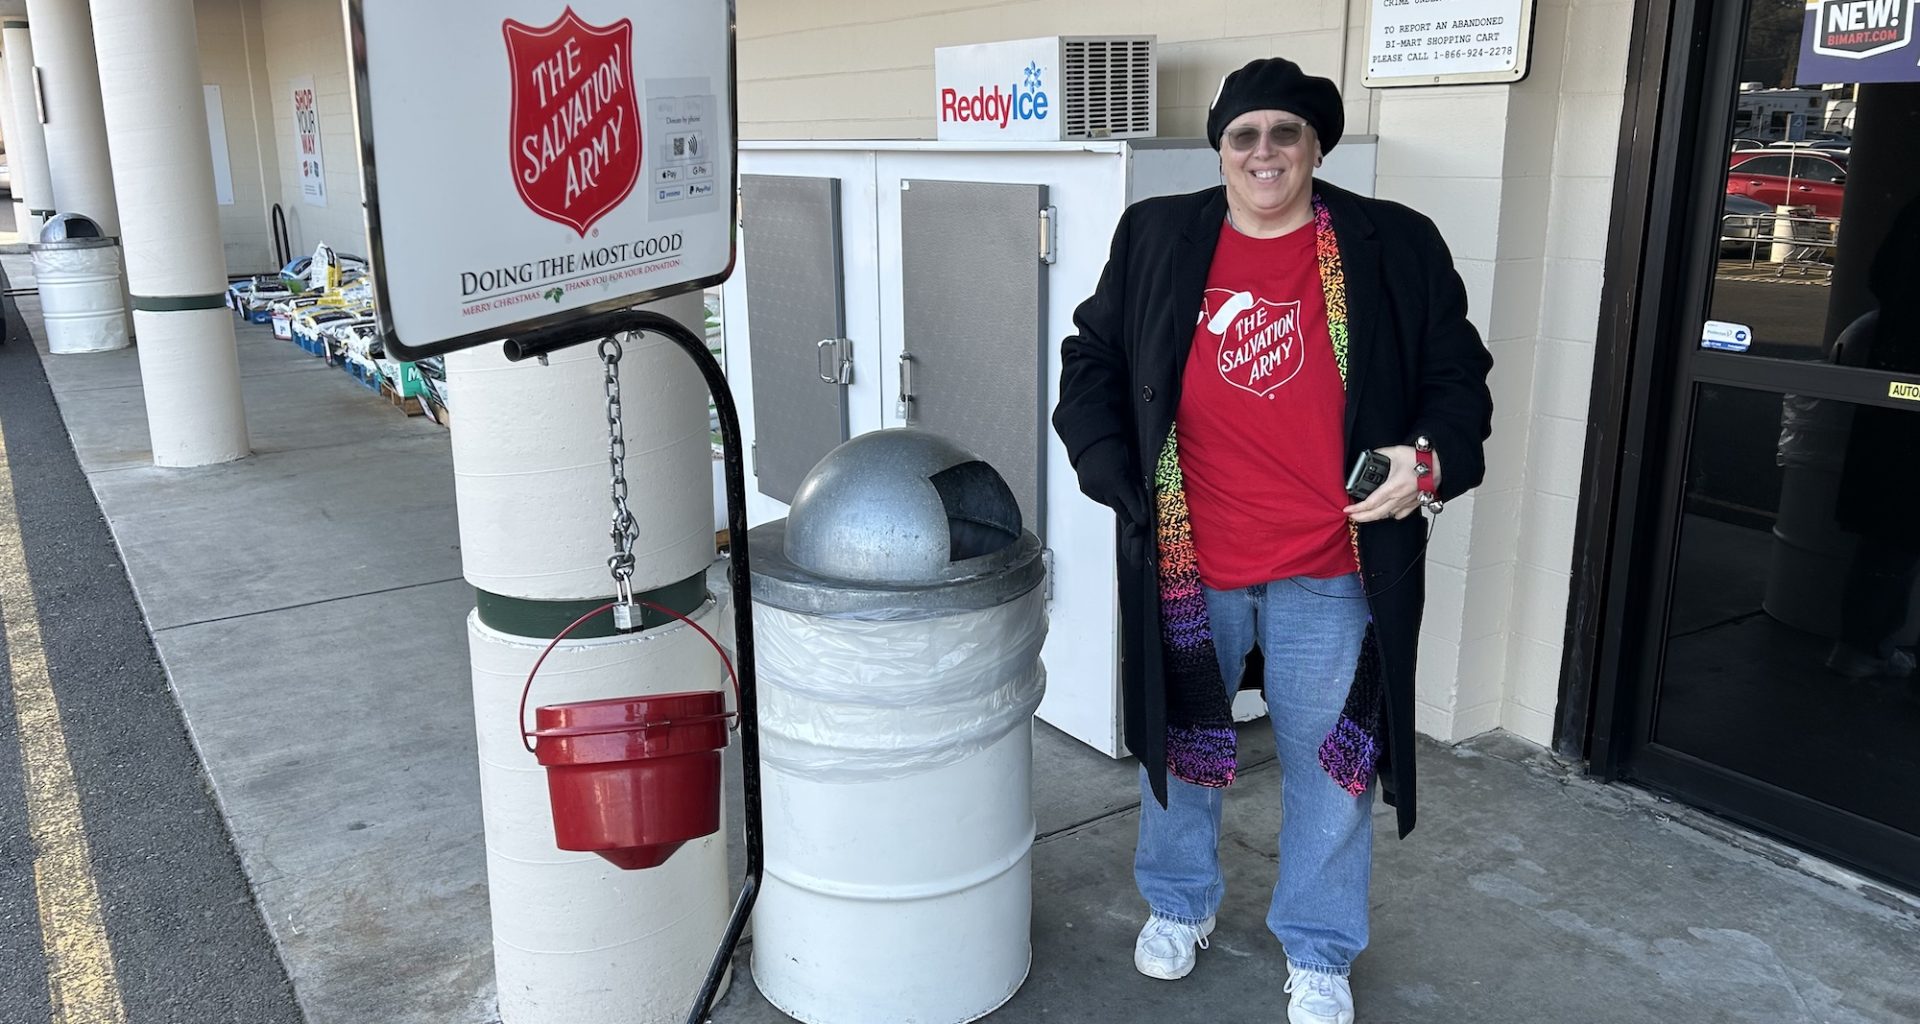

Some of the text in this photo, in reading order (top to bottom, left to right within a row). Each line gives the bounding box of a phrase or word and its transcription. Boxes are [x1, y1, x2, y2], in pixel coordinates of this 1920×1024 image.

[1384, 16, 1504, 35] TO REPORT AN ABANDONED
[1828, 0, 1901, 33] NEW!
[1385, 32, 1500, 49] BI-MART SHOPPING CART
[1827, 29, 1897, 46] BIMART.COM
[1373, 46, 1513, 63] PLEASE CALL 1-866-924-2278
[532, 37, 582, 108] THE
[294, 89, 313, 111] SHOP
[522, 43, 624, 184] SALVATION
[296, 110, 316, 134] YOUR
[301, 134, 316, 155] WAY
[565, 105, 623, 209] ARMY
[667, 170, 677, 179] Pay
[460, 233, 683, 296] DOING THE MOST GOOD
[462, 259, 680, 317] MERRY CHRISTMAS THANK YOU FOR YOUR DONATION
[1221, 309, 1295, 373] SALVATION
[1235, 307, 1267, 342] THE
[1248, 337, 1293, 386] ARMY
